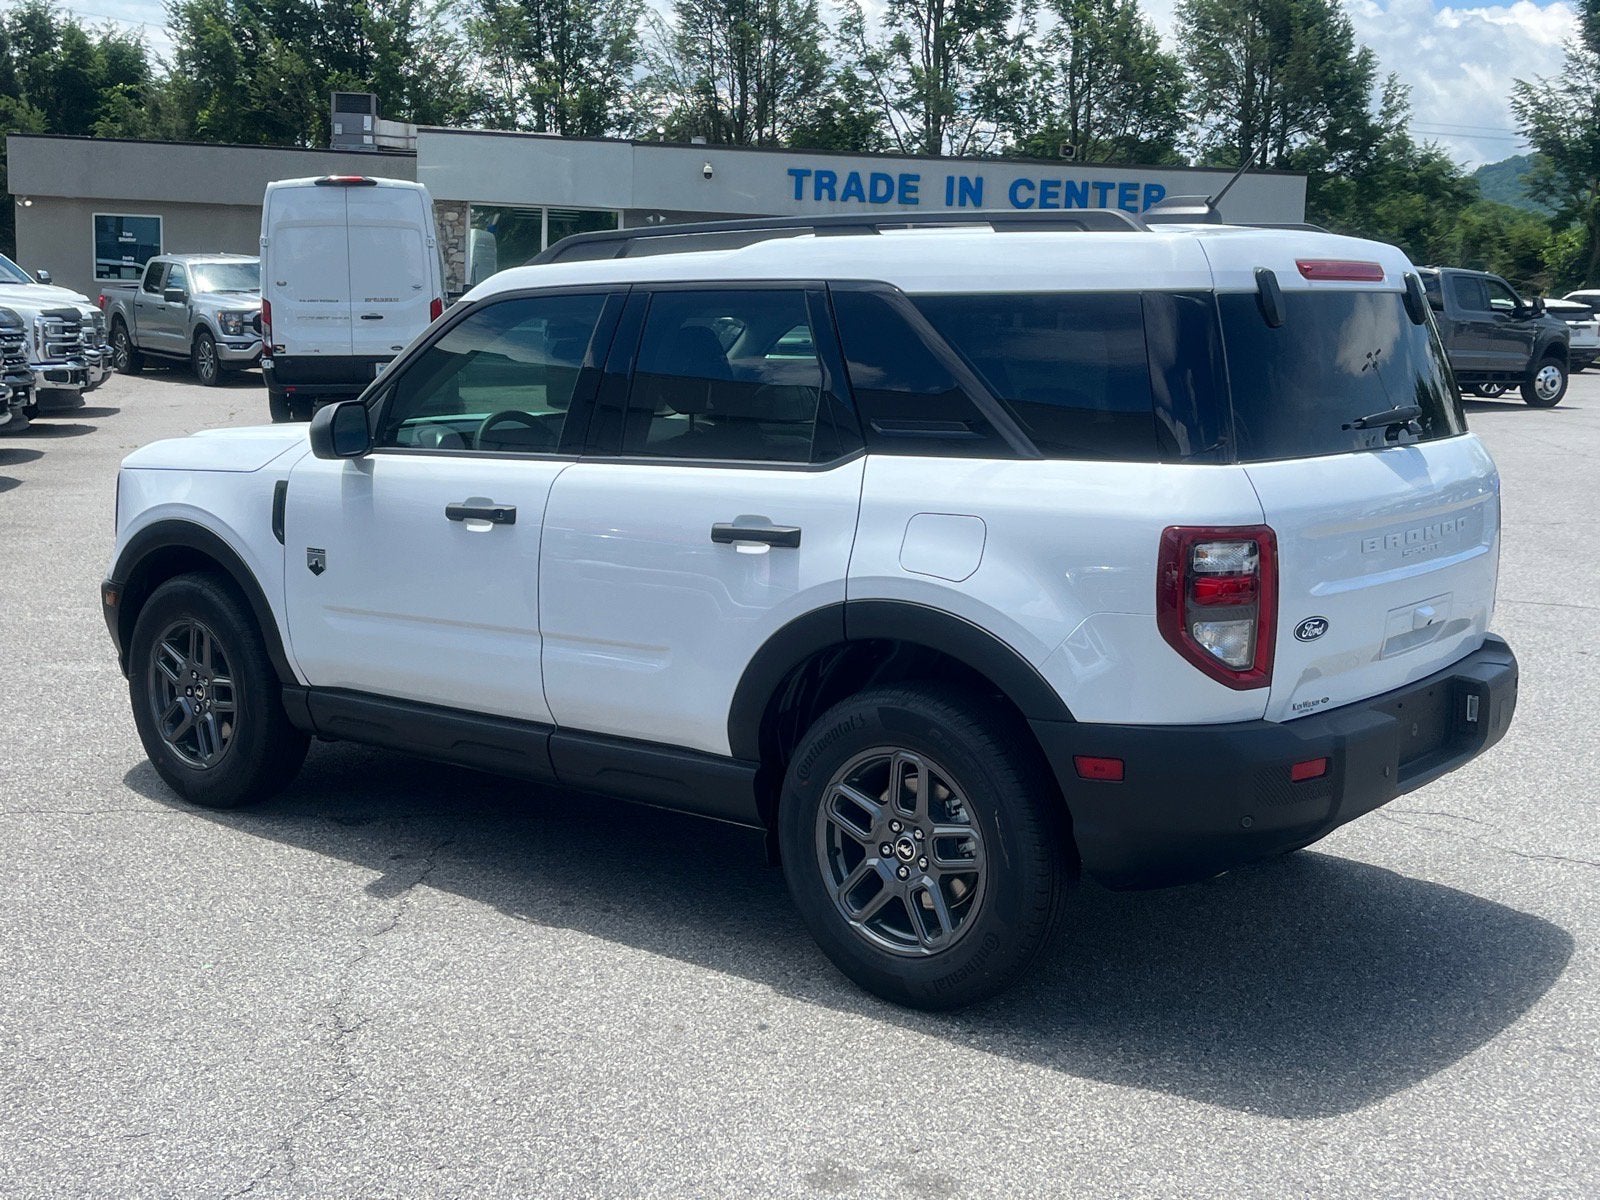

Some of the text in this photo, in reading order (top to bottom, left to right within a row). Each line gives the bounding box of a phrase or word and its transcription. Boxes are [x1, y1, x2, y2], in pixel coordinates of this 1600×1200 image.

[787, 169, 1166, 213] TRADE IN CENTER
[1361, 517, 1467, 553] BRONCO
[1301, 619, 1325, 638] Ford
